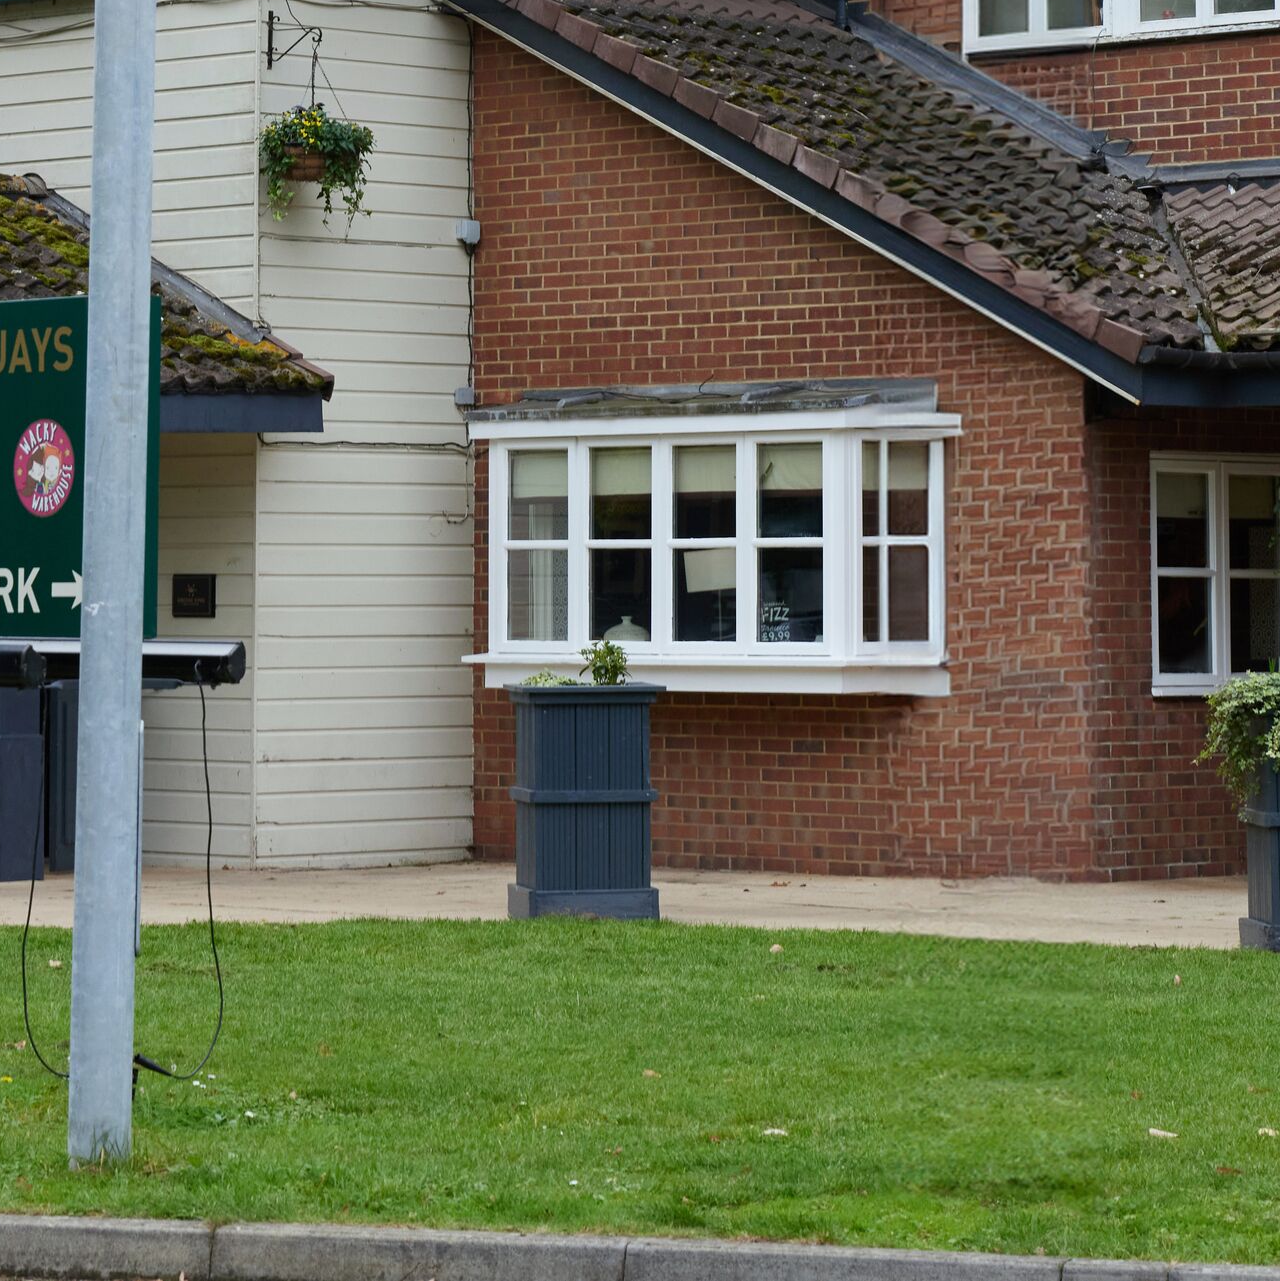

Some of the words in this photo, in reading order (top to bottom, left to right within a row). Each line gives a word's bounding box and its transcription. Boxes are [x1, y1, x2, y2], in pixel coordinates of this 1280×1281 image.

[19, 422, 57, 455] WACKY
[31, 464, 73, 512] WAREHOUSE
[761, 606, 790, 623] FIZZ
[762, 631, 790, 642] £9.99
